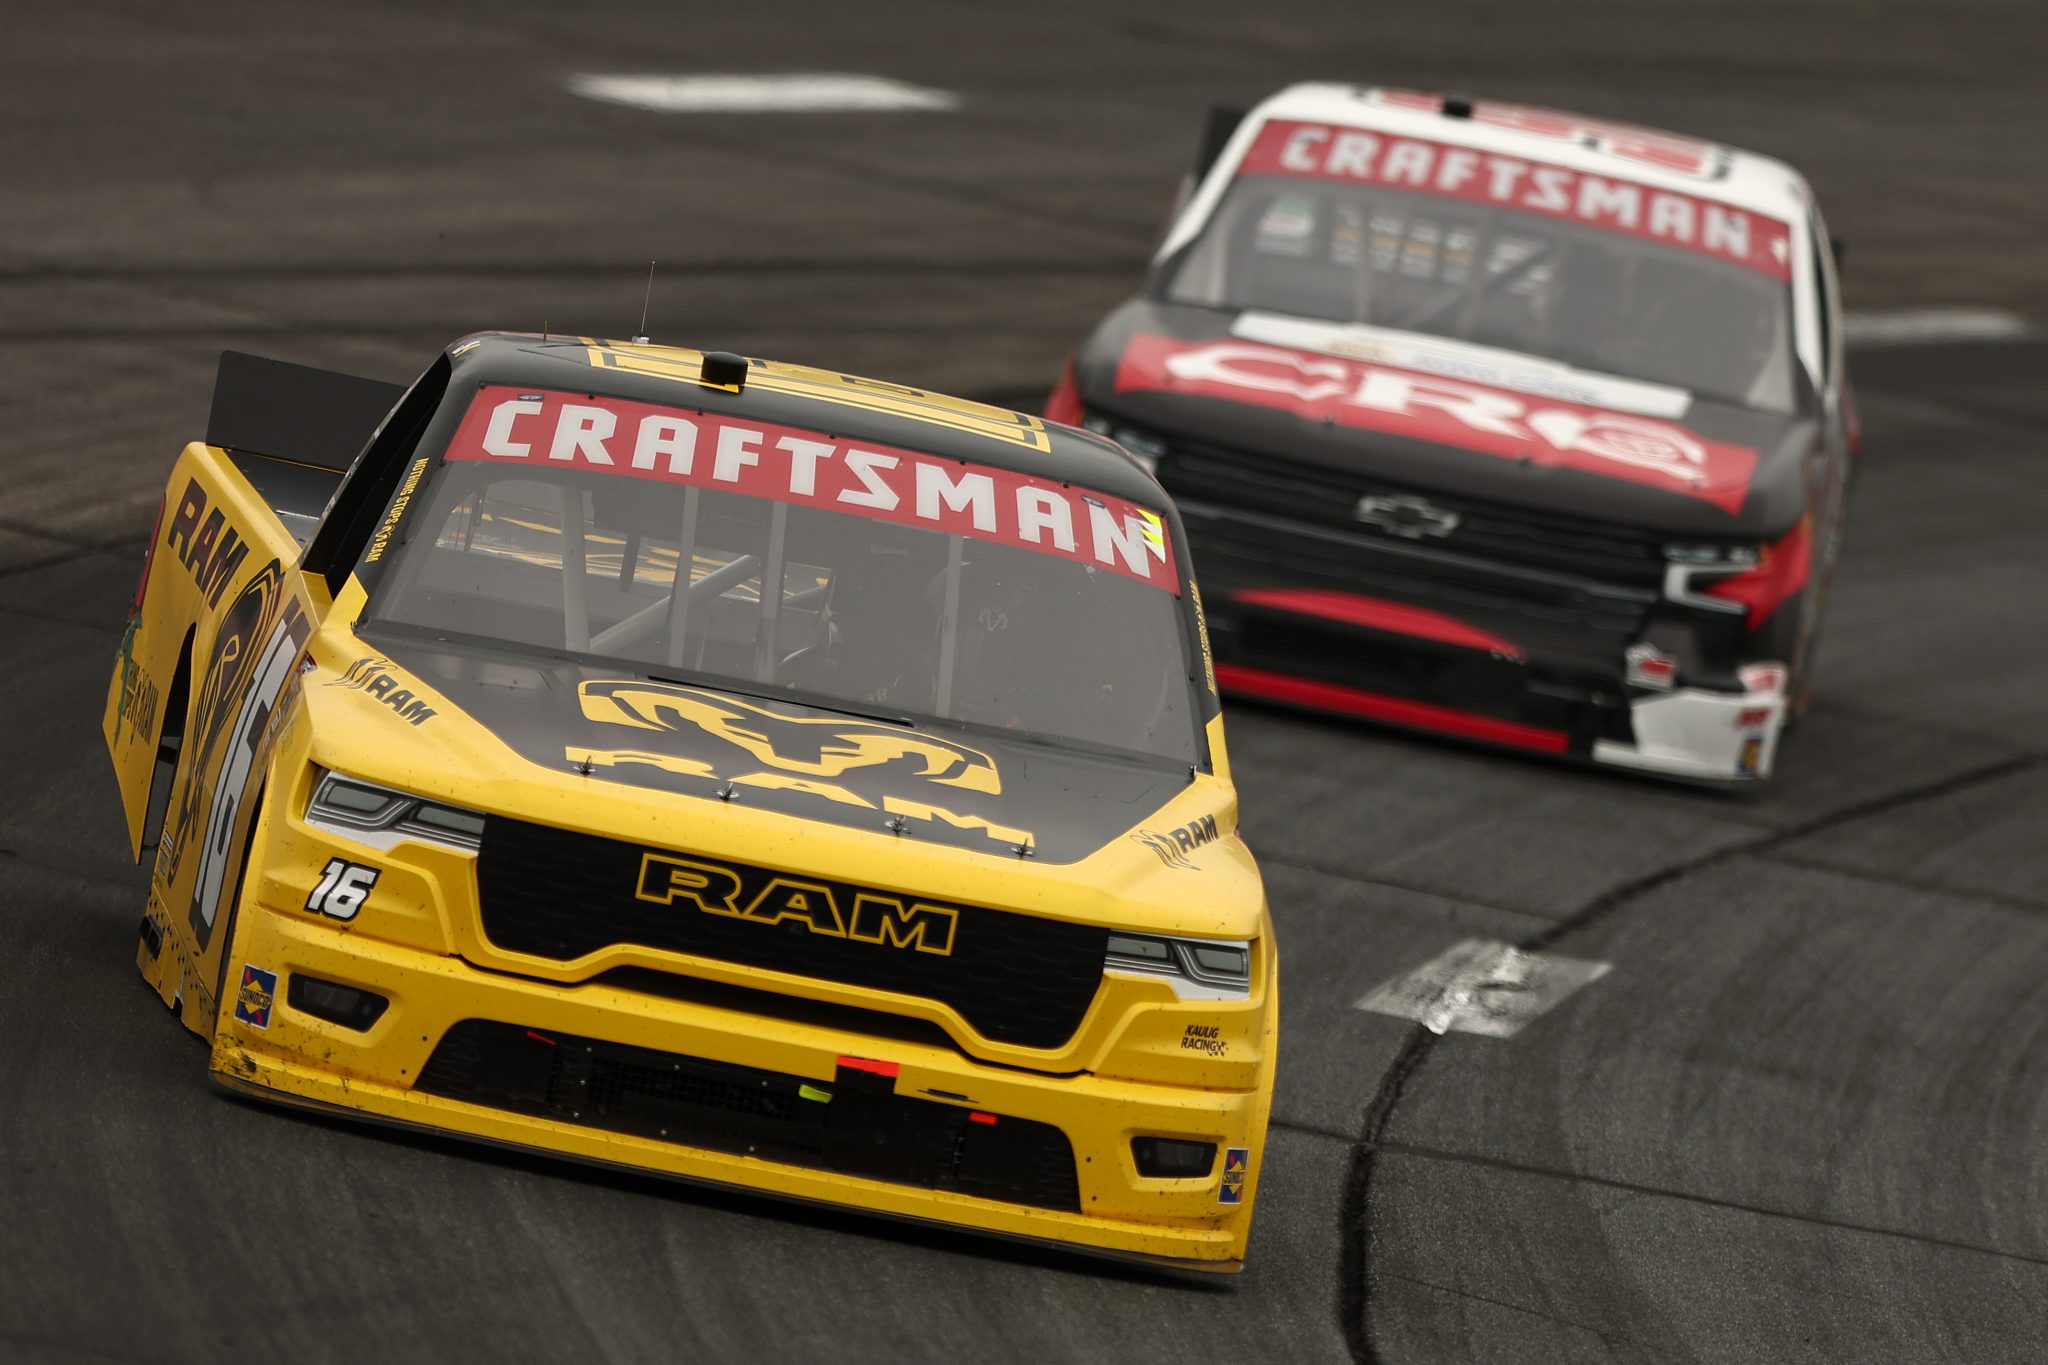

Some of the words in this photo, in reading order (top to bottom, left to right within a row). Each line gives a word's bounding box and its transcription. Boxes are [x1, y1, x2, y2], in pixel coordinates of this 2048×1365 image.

[1281, 127, 1751, 261] CRAFTSMAN
[400, 457, 429, 496] NOTHING
[482, 400, 1150, 578] CRAFTSMAN
[385, 496, 410, 525] STOPS
[167, 477, 249, 612] RAM
[365, 541, 388, 563] RAM
[364, 674, 438, 727] RAM
[1174, 813, 1219, 855] RAM
[304, 857, 382, 922] 16
[635, 853, 960, 957] RAM
[239, 987, 272, 1008] SUNOCO
[1181, 1037, 1217, 1052] RACING
[1185, 1025, 1219, 1039] KAULIG
